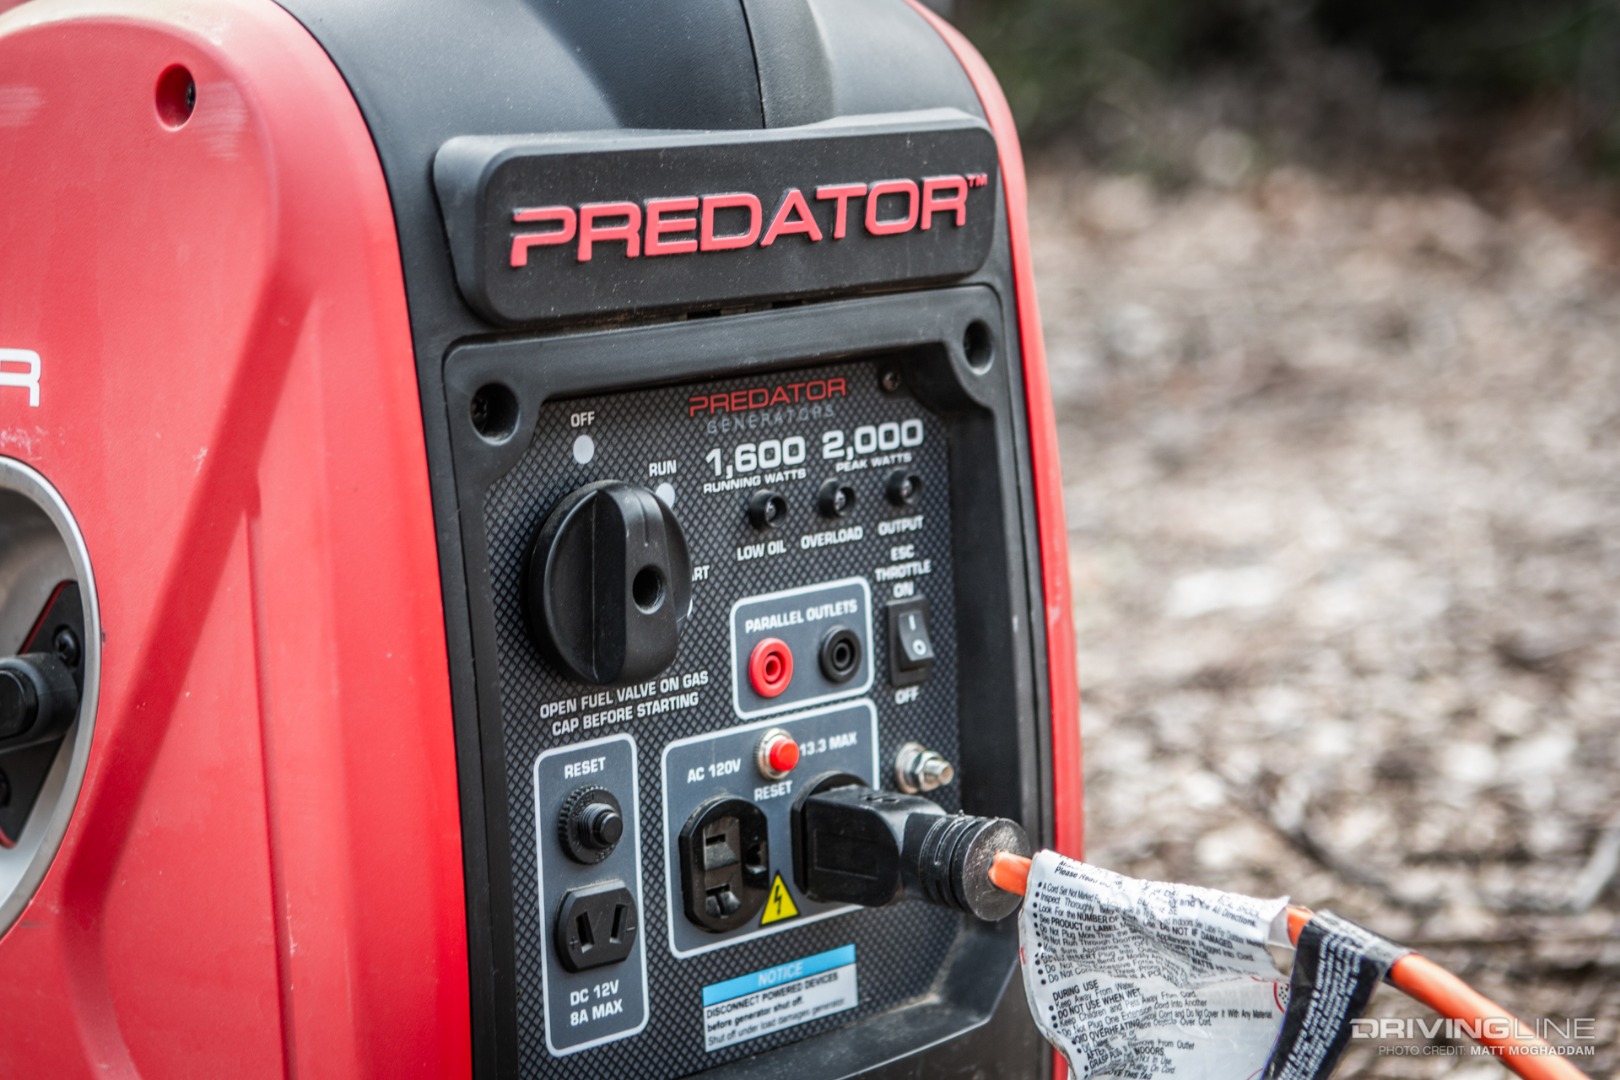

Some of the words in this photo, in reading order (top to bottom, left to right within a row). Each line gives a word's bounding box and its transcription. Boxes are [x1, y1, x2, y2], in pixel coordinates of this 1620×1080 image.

[510, 175, 968, 267] PREDATOR
[689, 377, 847, 417] PREDATOR
[570, 411, 595, 428] OFF
[707, 404, 835, 434] GENERATORS
[705, 436, 806, 479] 1,600
[822, 419, 925, 461] 2,000
[649, 460, 677, 477] RUN
[835, 459, 868, 473] PEAK
[871, 452, 912, 467] WATTS
[703, 475, 761, 494] RUNNING
[764, 468, 807, 485] WATTS
[878, 515, 924, 536] OUTPUT
[736, 544, 765, 561] LOW
[767, 539, 787, 555] OIL
[799, 526, 863, 550] OVERLOAD
[890, 544, 915, 561] ESC
[875, 559, 932, 583] THROTTLE
[893, 582, 915, 599] ON
[744, 609, 804, 634] PARALLEL
[806, 599, 858, 622] OUTLETS
[539, 696, 578, 719] OPEN
[580, 691, 614, 712] FUEL
[616, 680, 657, 703] VALVE
[660, 677, 680, 695] ON
[682, 670, 709, 690] GAS
[894, 686, 921, 704] OFF
[551, 717, 579, 738] CAP
[583, 706, 634, 731] BEFORE
[636, 691, 700, 718] STARTING
[800, 738, 827, 757] 13.3
[829, 731, 858, 750] MAX
[563, 756, 607, 780] RESET
[686, 766, 706, 784] AC
[708, 758, 742, 778] 120V
[754, 780, 793, 802] RESET
[1055, 866, 1078, 879] Please
[1047, 883, 1060, 894] Cord
[1039, 903, 1052, 914] Look
[1055, 906, 1064, 916] For
[1066, 910, 1075, 919] the
[1076, 911, 1108, 924] NUMBER
[1041, 892, 1060, 905] Inspect
[1065, 897, 1095, 914] Thoroughly
[1172, 926, 1189, 936] NOT
[1051, 916, 1084, 932] PRODUCT
[1092, 924, 1119, 932] LABEL
[1061, 929, 1076, 941] Plug
[758, 961, 804, 987] NOTICE
[1044, 964, 1056, 974] Do
[1047, 973, 1060, 984] Do
[1059, 969, 1074, 980] Not
[570, 988, 590, 1007] DC
[592, 979, 620, 1000] 12V
[706, 995, 760, 1019] DISCONNECT
[762, 982, 804, 1002] POWERED
[805, 972, 839, 990] DEVICES
[1052, 984, 1081, 1001] DURING
[1082, 979, 1099, 992] USE
[1055, 1000, 1072, 1010] Keep
[1074, 993, 1093, 1004] Away
[1094, 987, 1113, 998] From
[570, 1008, 589, 1026] 8A
[592, 998, 624, 1021] MAX
[707, 1018, 733, 1033] before
[734, 1007, 771, 1026] generator
[773, 1000, 790, 1014] shut
[1057, 1008, 1069, 1020] DO
[1069, 1003, 1084, 1016] NOT
[1085, 999, 1102, 1011] USE
[1101, 992, 1125, 1006] WHEN
[1059, 1017, 1077, 1028] Keep
[1078, 1008, 1107, 1022] Children
[1109, 1003, 1123, 1014] and
[1141, 994, 1158, 1004] Away
[1161, 991, 1179, 1000] From
[1088, 1020, 1104, 1031] Plug
[1104, 1016, 1120, 1025] One
[1120, 1006, 1153, 1021] Extension
[1154, 1000, 1170, 1010] Cord
[1170, 1000, 1183, 1009] Into
[1184, 999, 1207, 1008] Another
[1158, 1009, 1173, 1019] Cord
[1174, 1009, 1185, 1019] and
[1185, 1008, 1195, 1018] Do
[1203, 1008, 1219, 1018] Cover
[1227, 1009, 1240, 1018] With
[1241, 1009, 1251, 1020] Any
[1300, 997, 1318, 1029] Safety
[708, 1034, 725, 1047] Shut
[738, 1023, 759, 1036] under
[760, 1017, 777, 1029] load
[1157, 1038, 1175, 1048] From
[1176, 1039, 1195, 1051] Outlet
[1123, 1068, 1139, 1079] THIS
[1150, 1064, 1160, 1073] On
